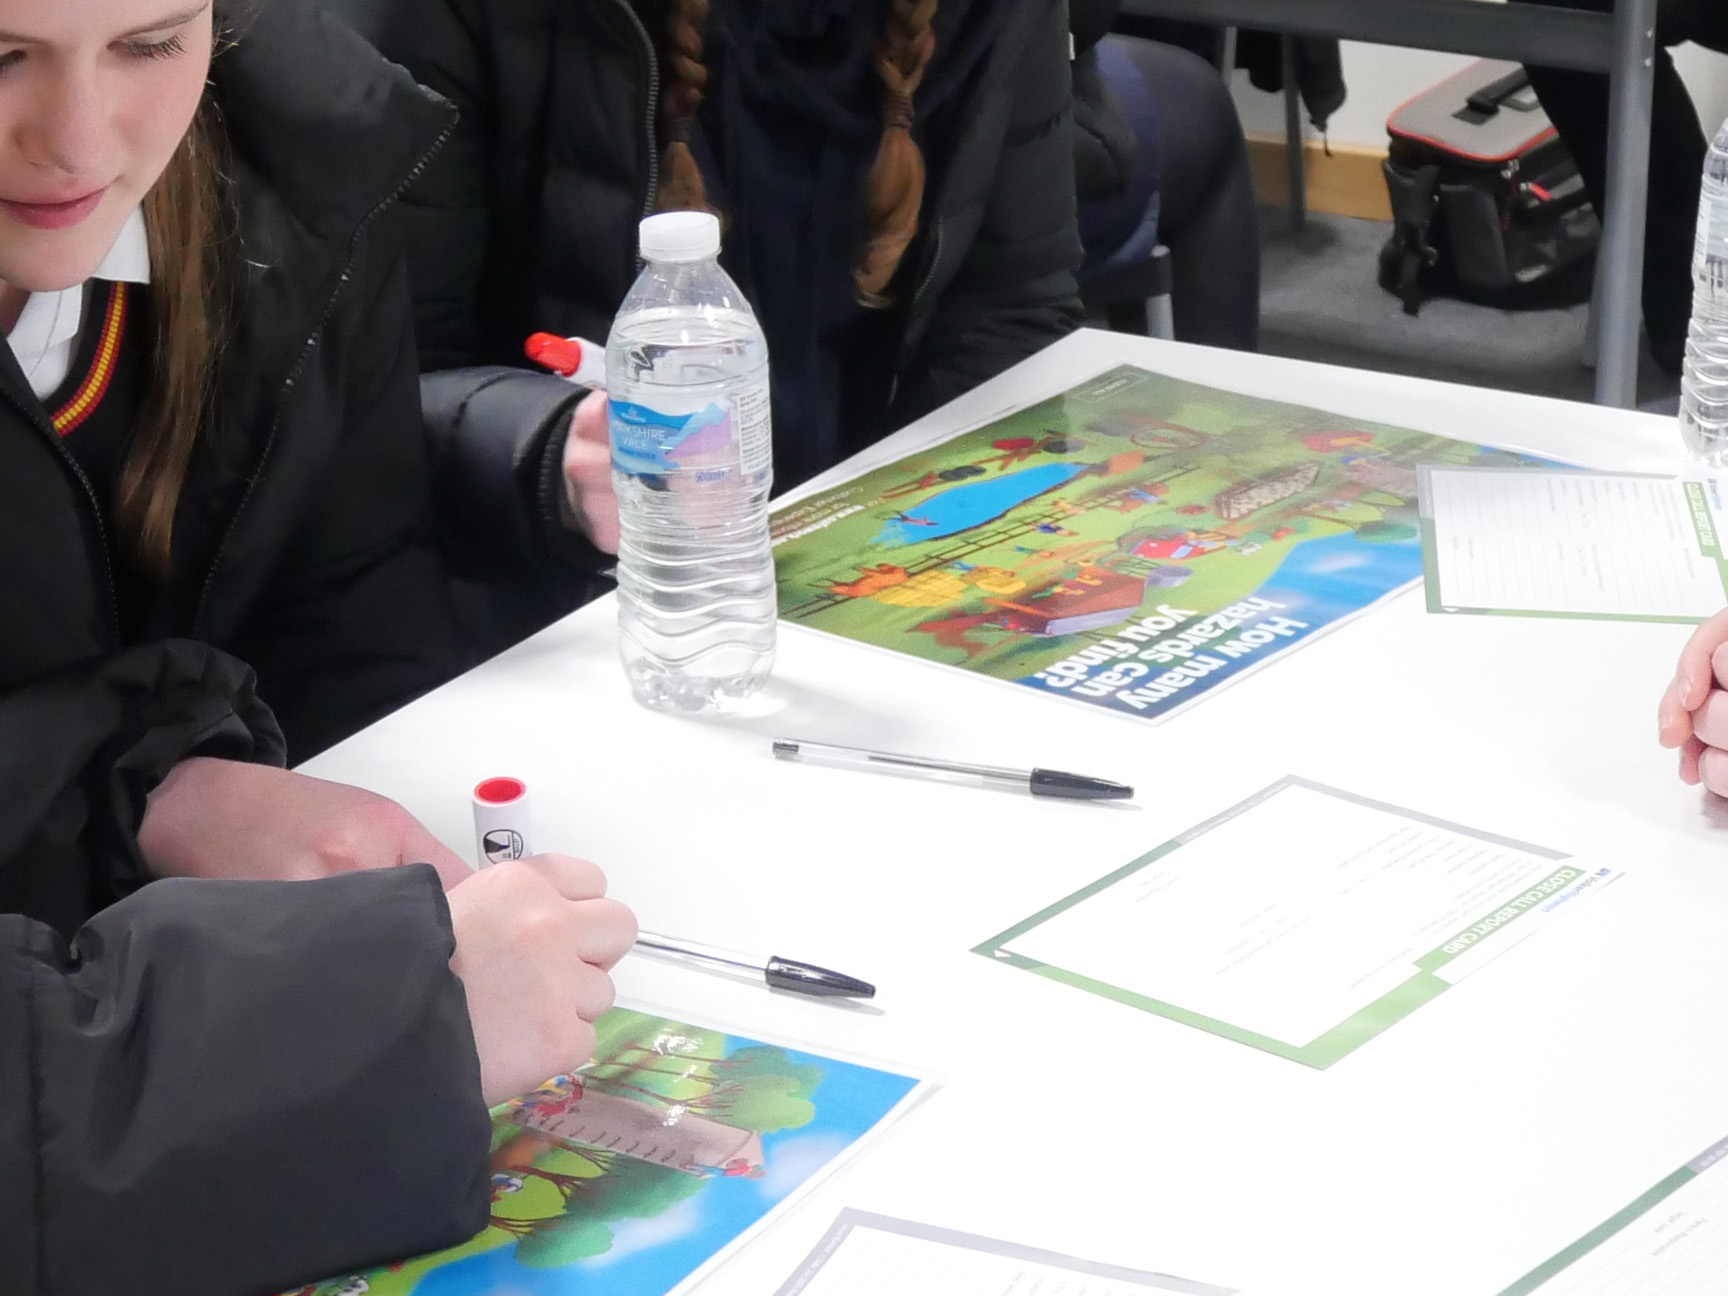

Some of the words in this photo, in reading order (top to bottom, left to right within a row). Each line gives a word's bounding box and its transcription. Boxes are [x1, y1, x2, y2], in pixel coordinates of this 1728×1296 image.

[1117, 604, 1200, 643] you
[1138, 596, 1288, 663] hazards
[1214, 616, 1309, 659] How
[1032, 638, 1140, 688] find?
[1070, 661, 1149, 698] can
[1115, 654, 1228, 710] many
[1508, 889, 1546, 909] CALL
[1533, 868, 1579, 893] CLOSE
[1468, 905, 1521, 935] REPORT
[1438, 931, 1481, 954] CARD
